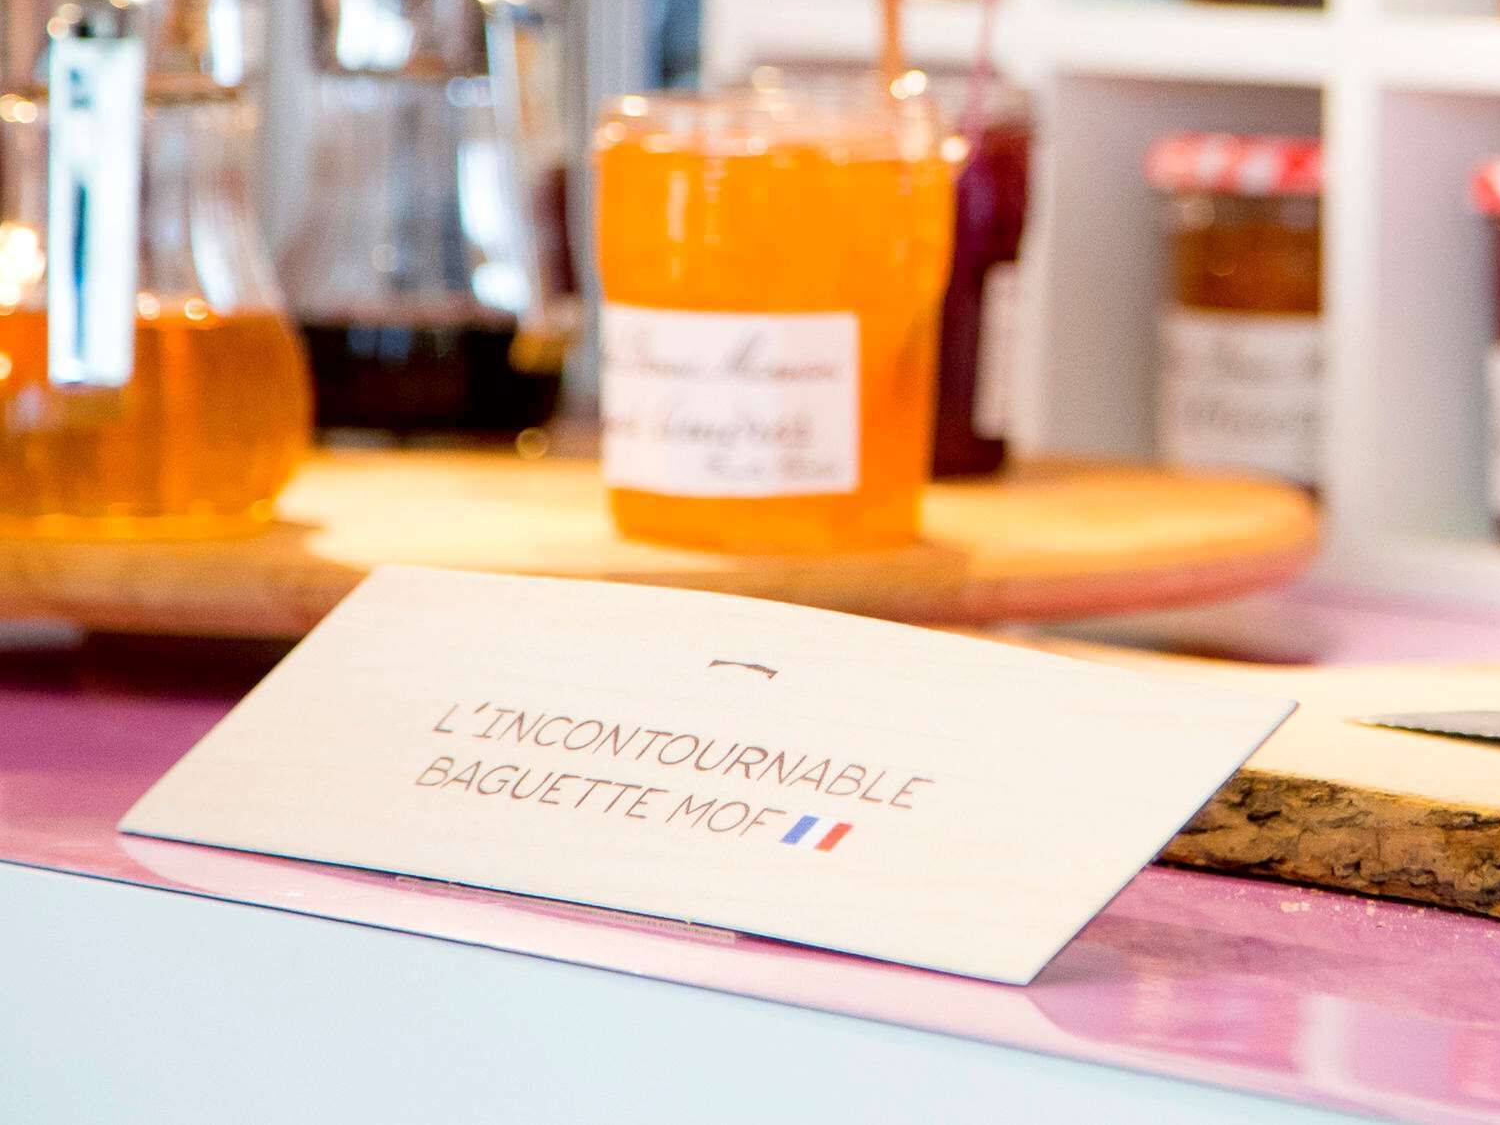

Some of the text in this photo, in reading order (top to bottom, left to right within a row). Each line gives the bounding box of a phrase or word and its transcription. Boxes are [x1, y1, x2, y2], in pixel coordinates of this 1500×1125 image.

[415, 756, 787, 836] BAGUETTE MOF
[431, 701, 936, 810] L'INCONTOURNABLE
